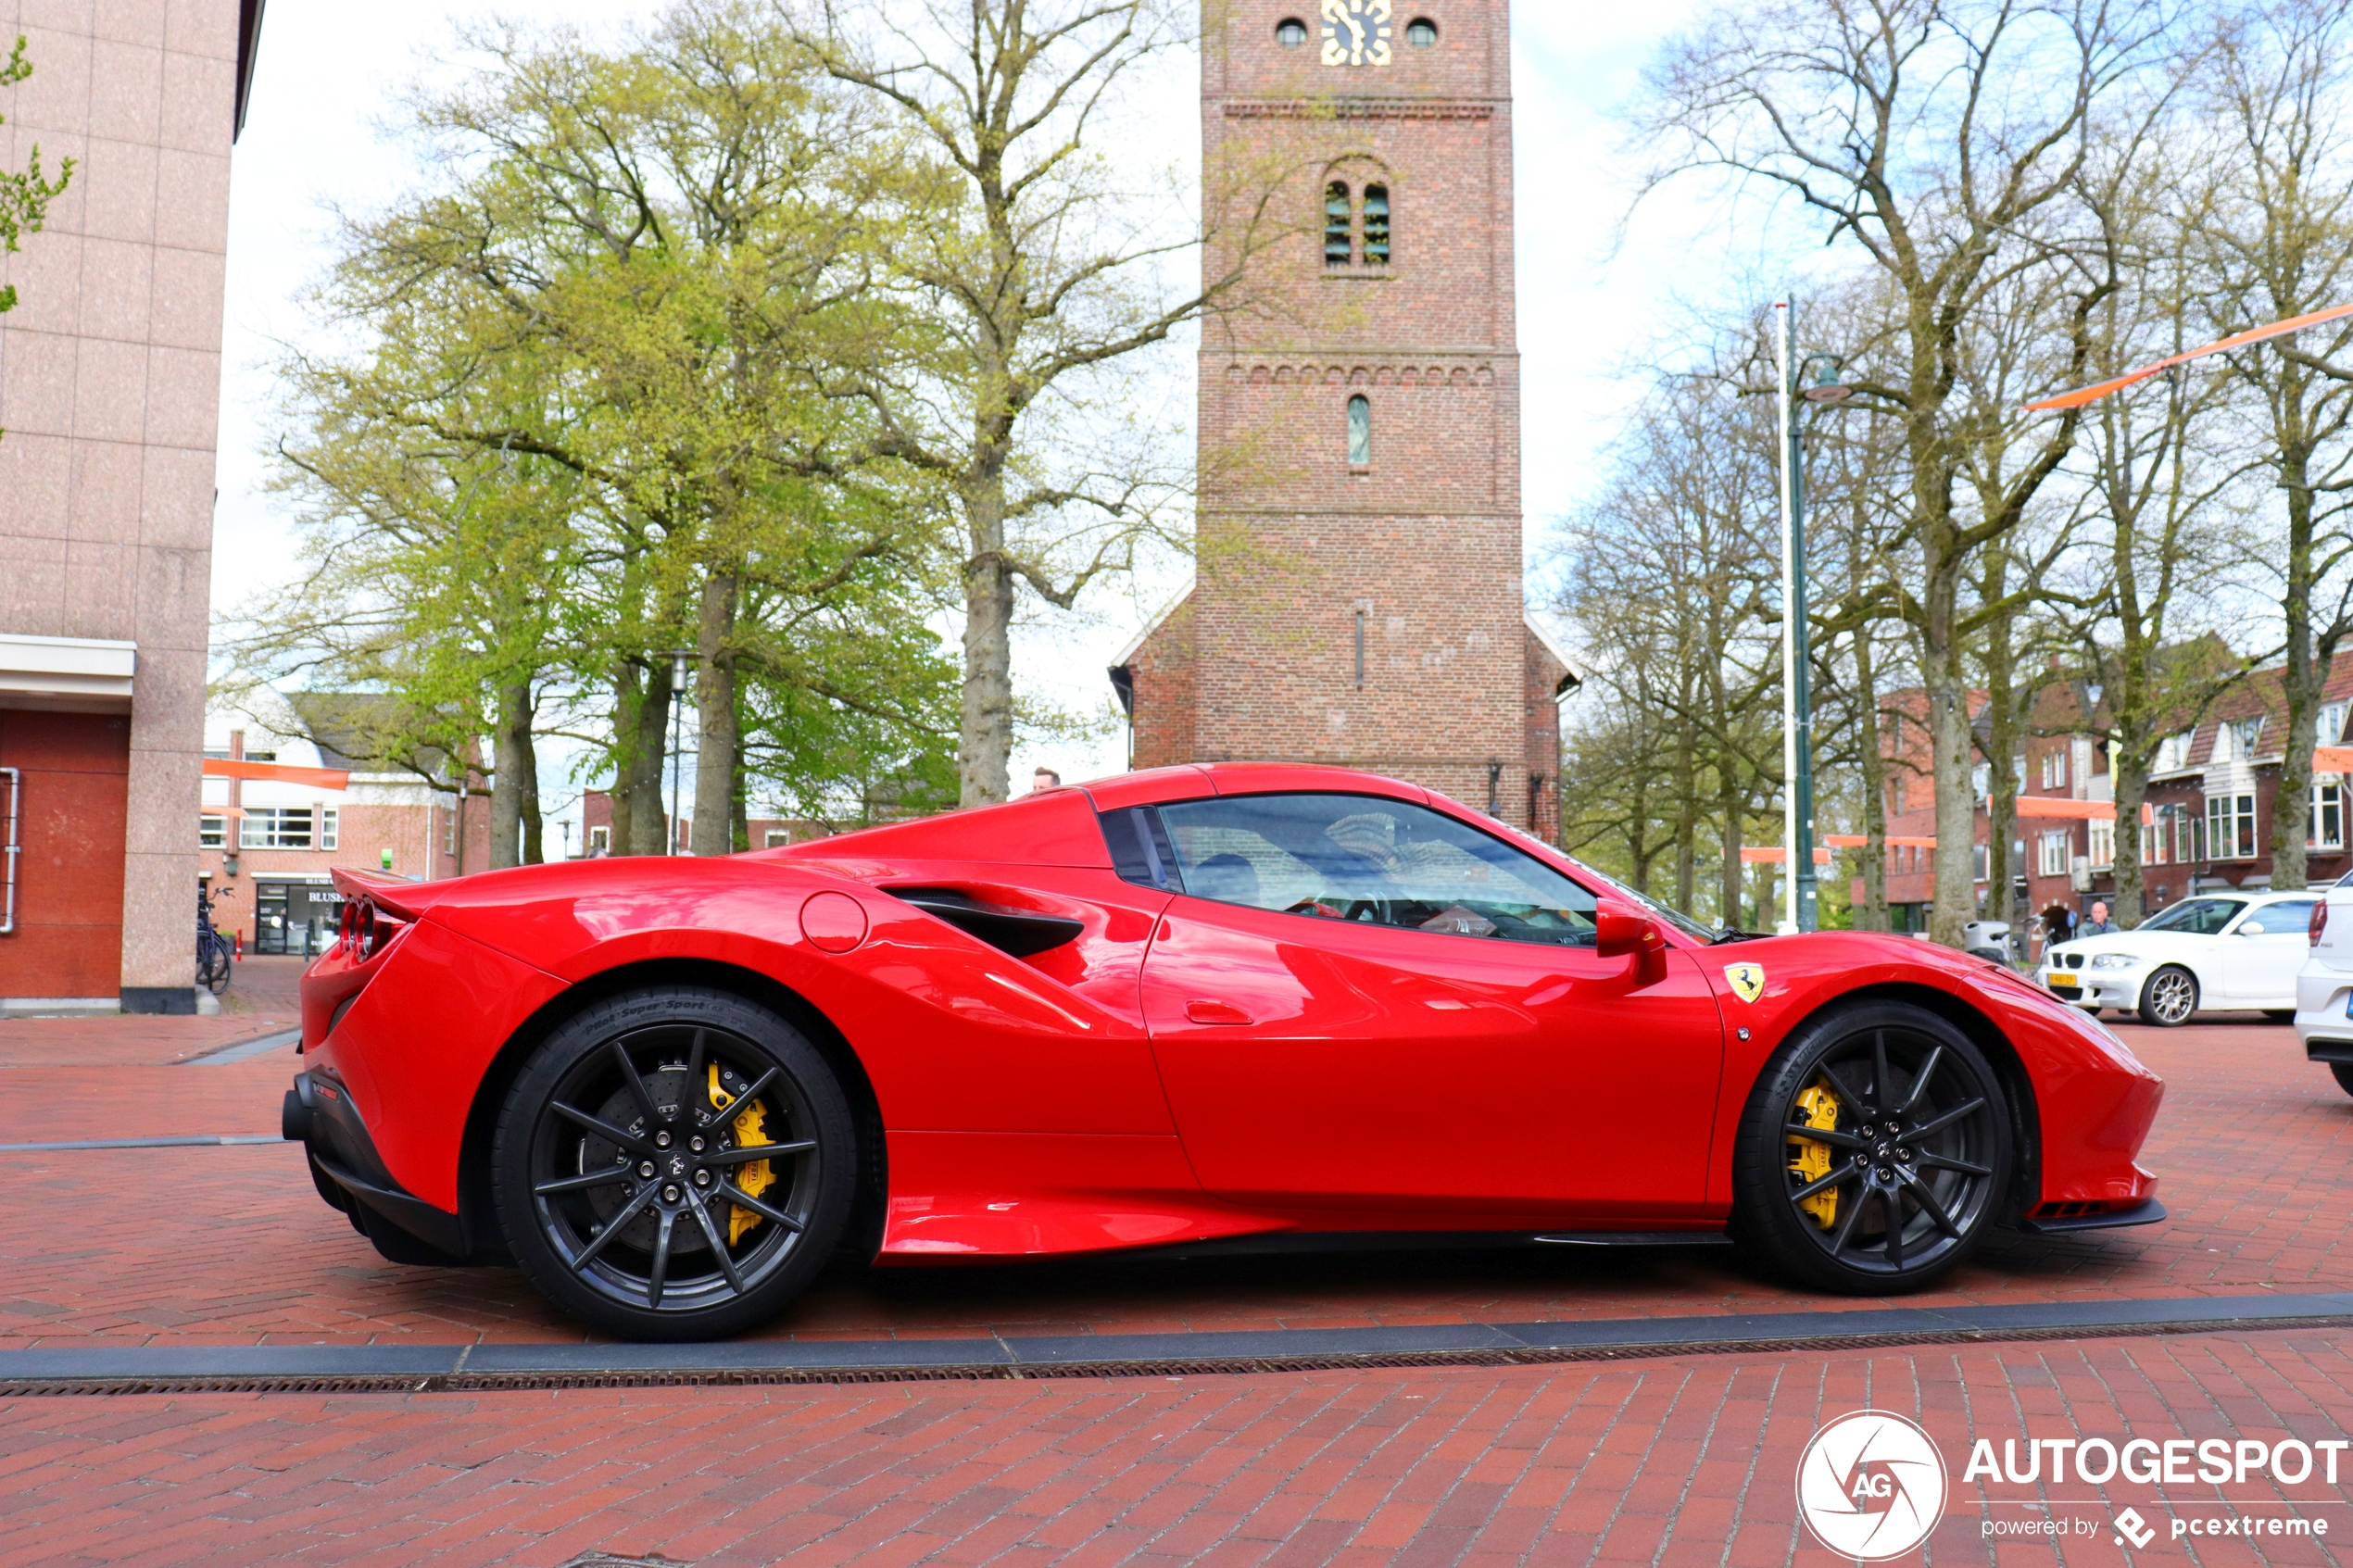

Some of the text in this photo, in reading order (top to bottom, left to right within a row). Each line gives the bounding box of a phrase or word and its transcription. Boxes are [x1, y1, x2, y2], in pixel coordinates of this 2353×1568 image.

[308, 892, 346, 902] BLUSH
[585, 1013, 615, 1035] Pilot
[622, 1002, 660, 1017] Super
[666, 999, 706, 1010] Sport
